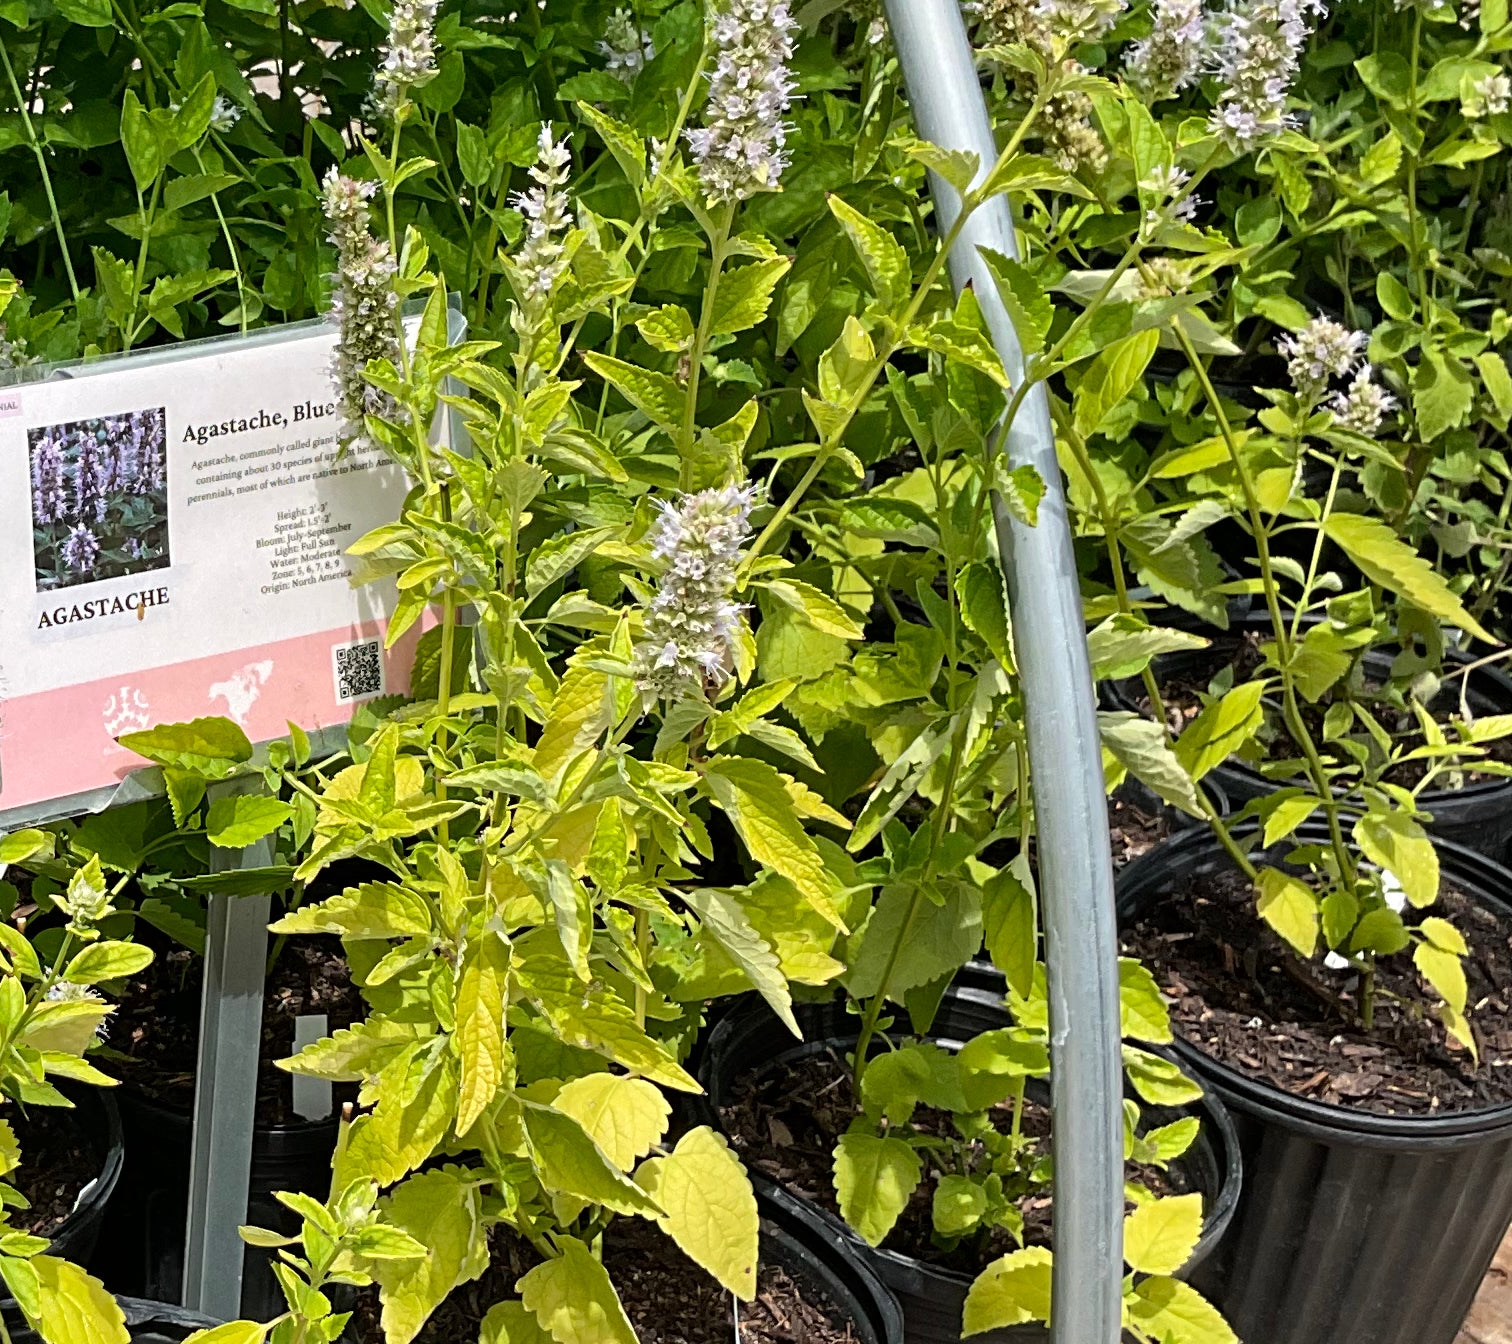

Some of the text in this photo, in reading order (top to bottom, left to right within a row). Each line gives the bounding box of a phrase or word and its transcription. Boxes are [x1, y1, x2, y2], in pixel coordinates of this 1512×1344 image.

[182, 401, 335, 445] Agastache, Blue
[192, 454, 238, 470] Agastache,
[240, 444, 285, 460] commonly
[286, 439, 310, 452] called
[312, 436, 334, 449] giant
[196, 470, 242, 486] containing
[245, 465, 269, 477] about
[271, 461, 282, 471] 30
[283, 456, 313, 470] species
[314, 453, 323, 463] of
[188, 487, 235, 506] perennials,
[237, 484, 258, 494] most
[259, 480, 268, 489] of
[270, 474, 295, 487] which
[298, 473, 311, 482] are
[312, 468, 338, 480] native
[340, 466, 349, 474] to
[350, 459, 374, 473] North
[274, 518, 306, 534] Spread:
[277, 507, 307, 521] Height:
[256, 536, 286, 549] Bloom:
[275, 537, 335, 558] Light: Full Sun
[270, 549, 341, 568] Water: Moderate
[272, 558, 340, 581] Zone: 5, 6, 7, 8, 9
[261, 569, 352, 595] Origin: North America
[38, 587, 170, 629] AGASTACHE
